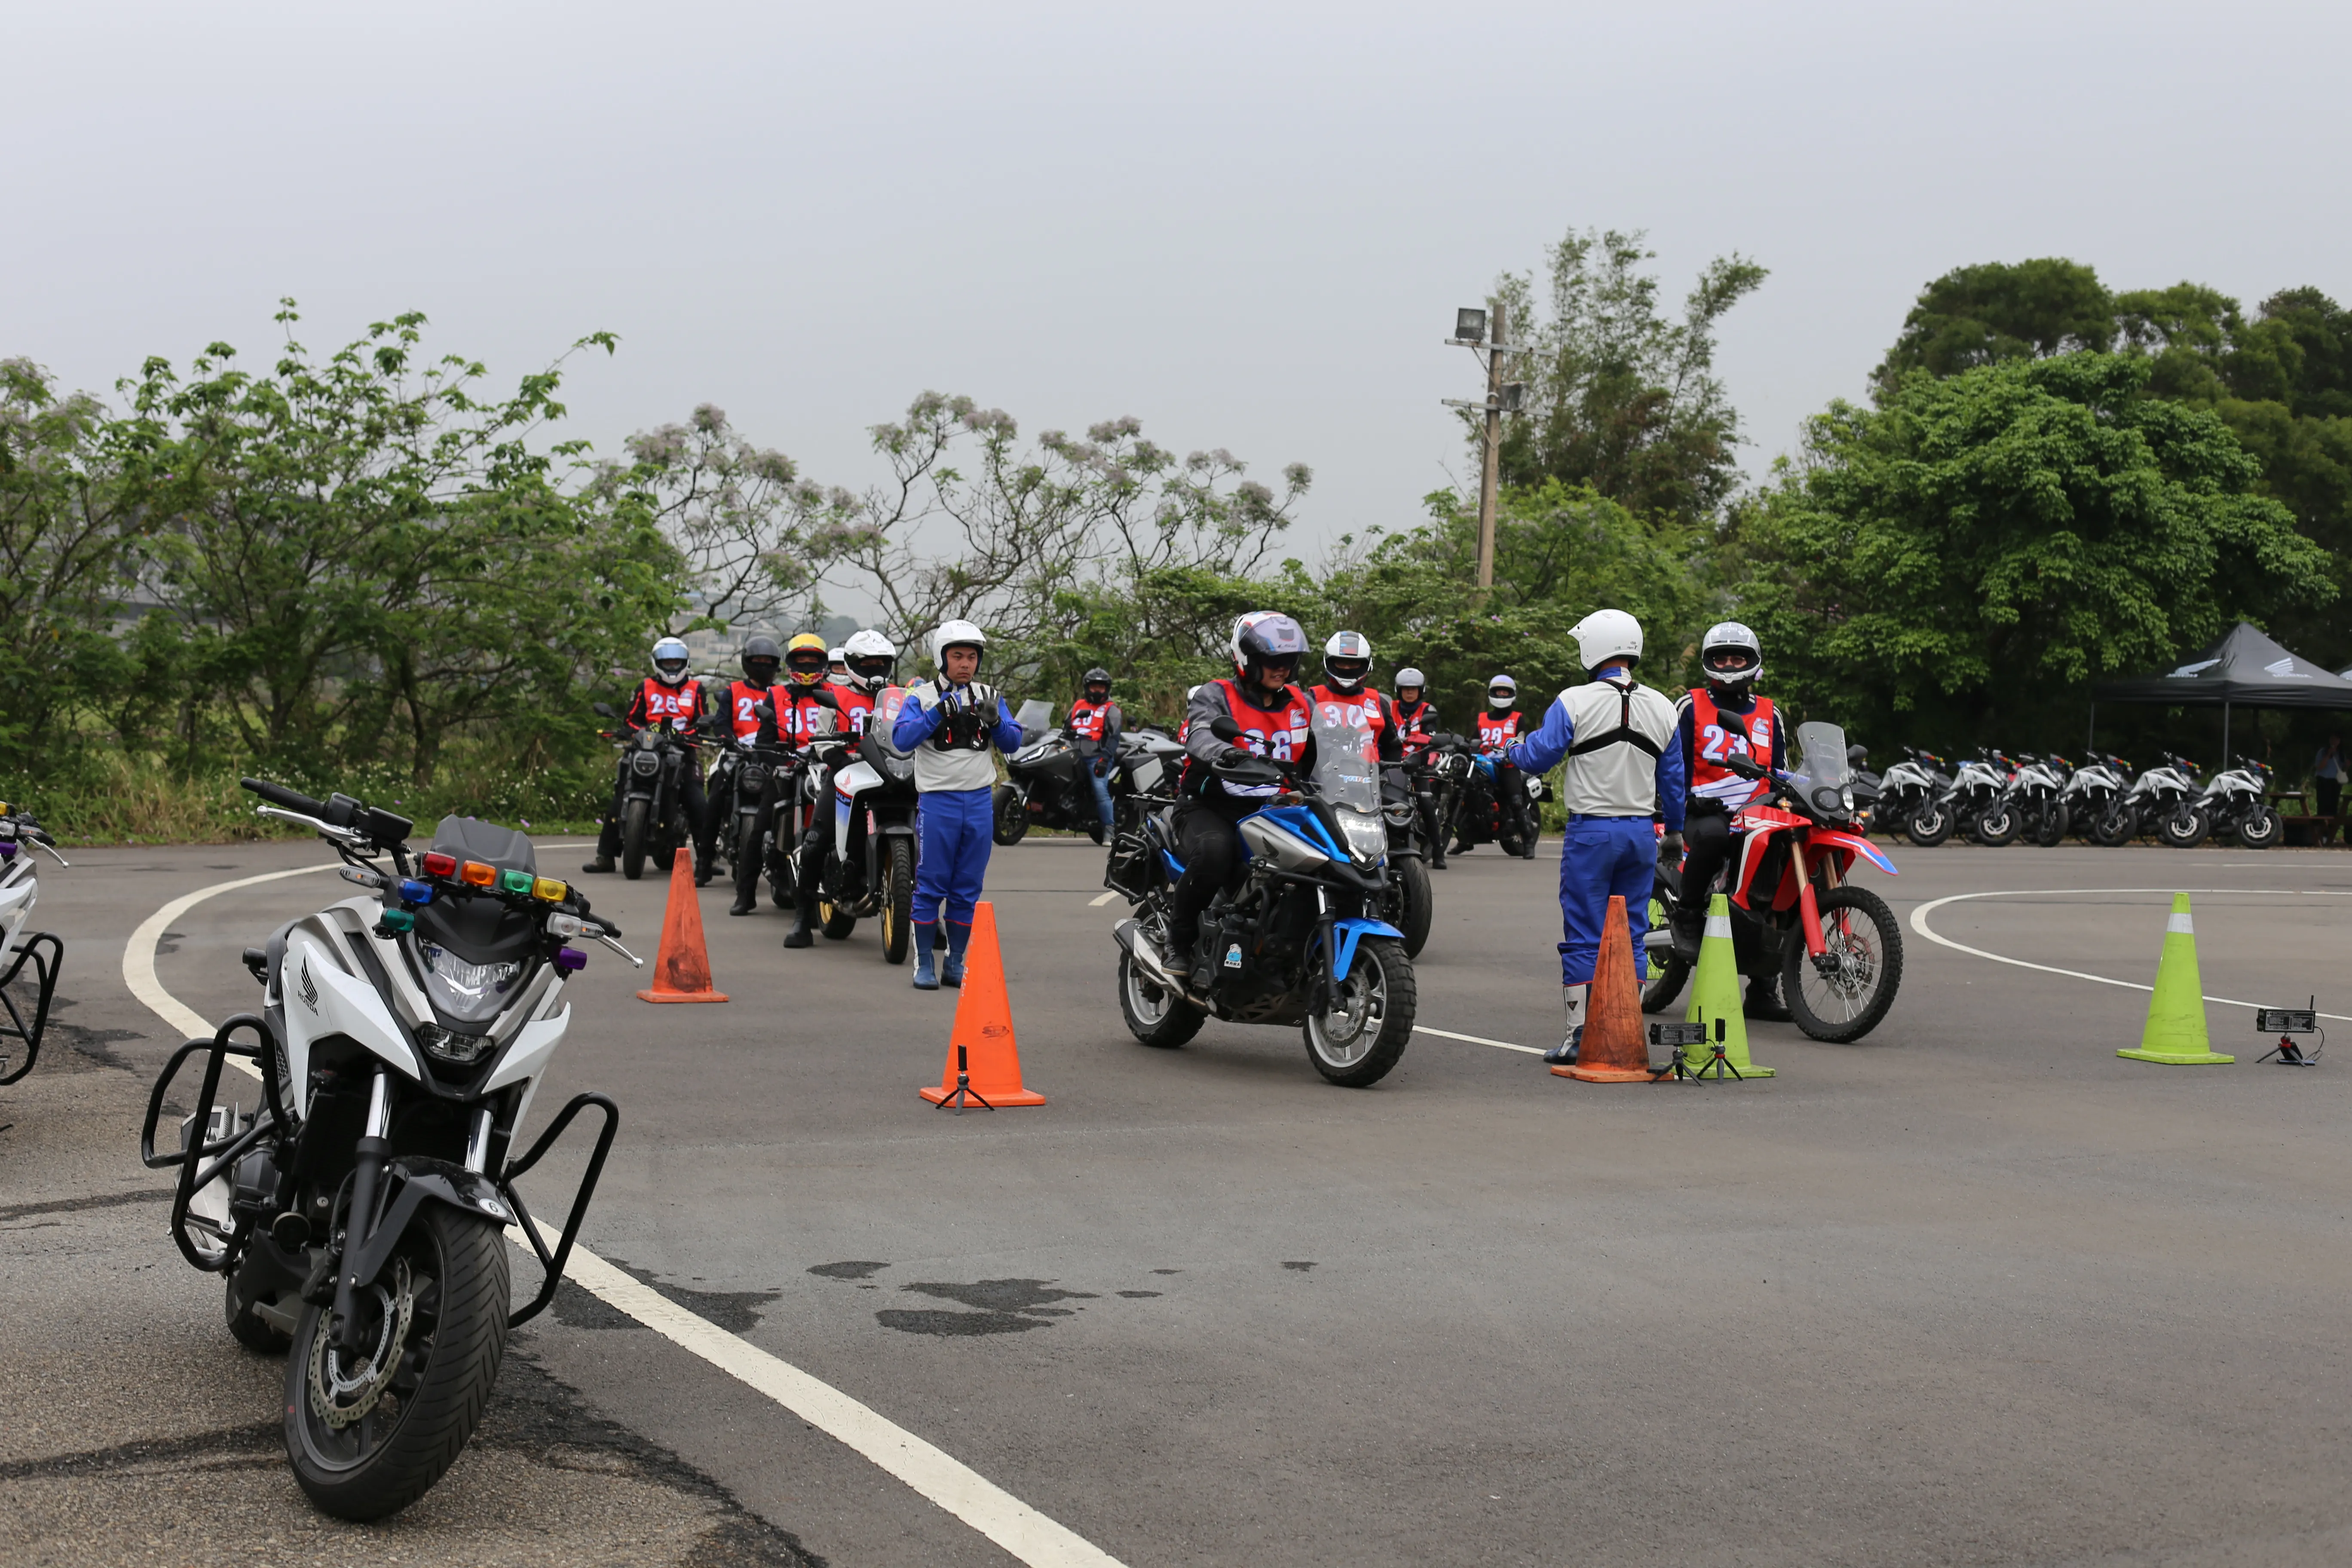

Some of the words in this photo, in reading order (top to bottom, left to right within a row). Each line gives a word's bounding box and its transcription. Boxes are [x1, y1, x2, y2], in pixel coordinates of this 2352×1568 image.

[650, 692, 680, 714] 25
[784, 707, 820, 734] 35
[1324, 704, 1367, 729] 30
[1243, 728, 1292, 760] 36
[1480, 726, 1503, 745] 28
[1702, 724, 1748, 761] 23
[297, 990, 319, 1017] HONDA
[488, 1202, 499, 1213] 6
